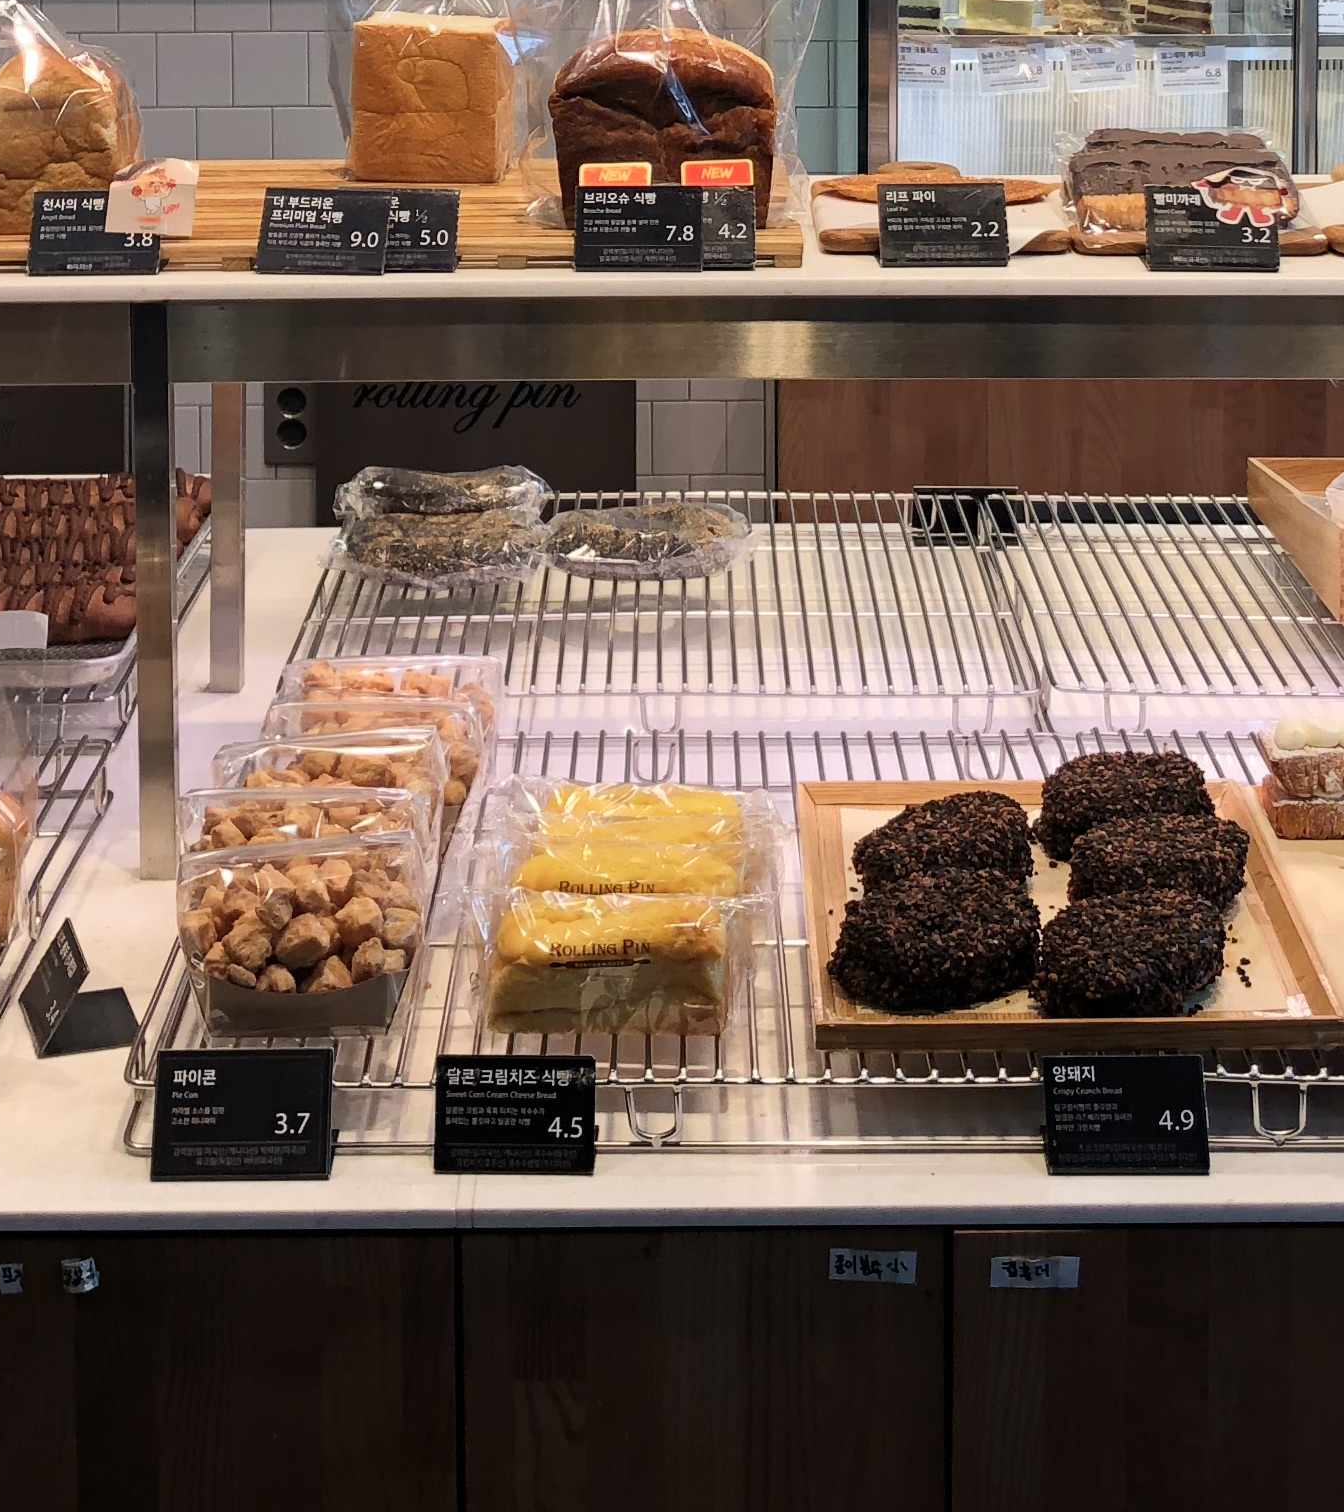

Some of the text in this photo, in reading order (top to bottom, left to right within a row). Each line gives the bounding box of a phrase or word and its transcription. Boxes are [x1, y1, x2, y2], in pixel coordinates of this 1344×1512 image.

[930, 66, 946, 76] 6.8
[1116, 63, 1132, 73] 6.8
[1206, 68, 1221, 77] 6.8
[599, 169, 632, 182] NEW
[701, 166, 733, 179] NEW
[273, 196, 334, 210] 더 부드러운
[583, 192, 657, 205] 브리오슈 식빵
[885, 190, 935, 203] 리프 파이
[1153, 193, 1202, 206] 빨미까레
[42, 198, 105, 211] 천사의 식빵
[270, 210, 344, 224] 프리미엄 식빵
[666, 225, 694, 241] 7.8
[718, 223, 747, 239] 4.2
[971, 221, 1000, 237] 2.2
[1242, 227, 1271, 243] 3.2
[124, 232, 153, 248] 3.8
[350, 231, 379, 247] 9.0
[420, 230, 448, 246] 5.0
[559, 881, 656, 895] ROLLING PIN
[551, 939, 650, 957] ROLLING PIN
[173, 1069, 216, 1086] 파이콘
[447, 1067, 572, 1086] 달콘 크림치즈 식빵
[1052, 1066, 1096, 1082] 앙돼지
[510, 1091, 535, 1099] Cheese
[1053, 1087, 1075, 1096] Crispy
[274, 1113, 310, 1134] 3.7
[548, 1117, 583, 1138] 4.5
[1159, 1109, 1194, 1131] 4.9
